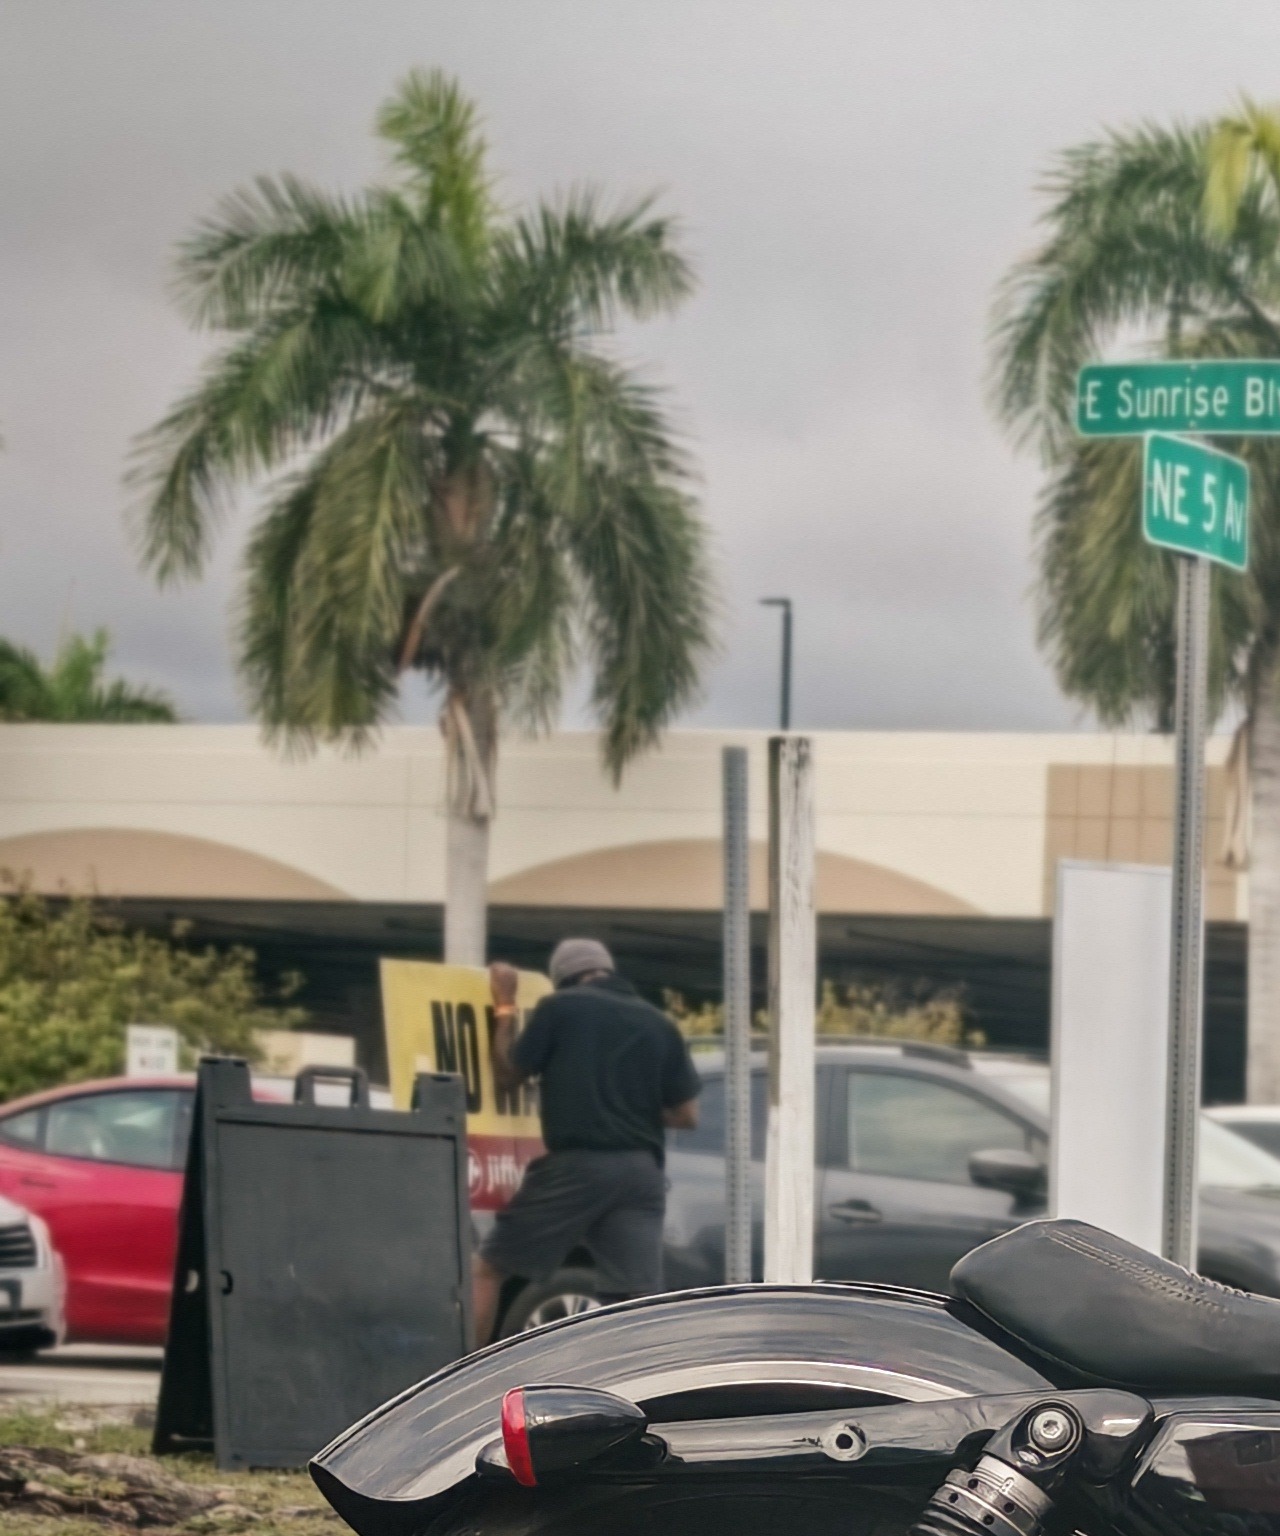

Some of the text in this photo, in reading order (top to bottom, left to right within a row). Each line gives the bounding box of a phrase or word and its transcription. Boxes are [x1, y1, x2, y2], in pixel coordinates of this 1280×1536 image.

[1086, 381, 1102, 420] E
[1116, 376, 1230, 419] Sunrise
[1152, 457, 1191, 526] NE
[1202, 473, 1217, 533] 5
